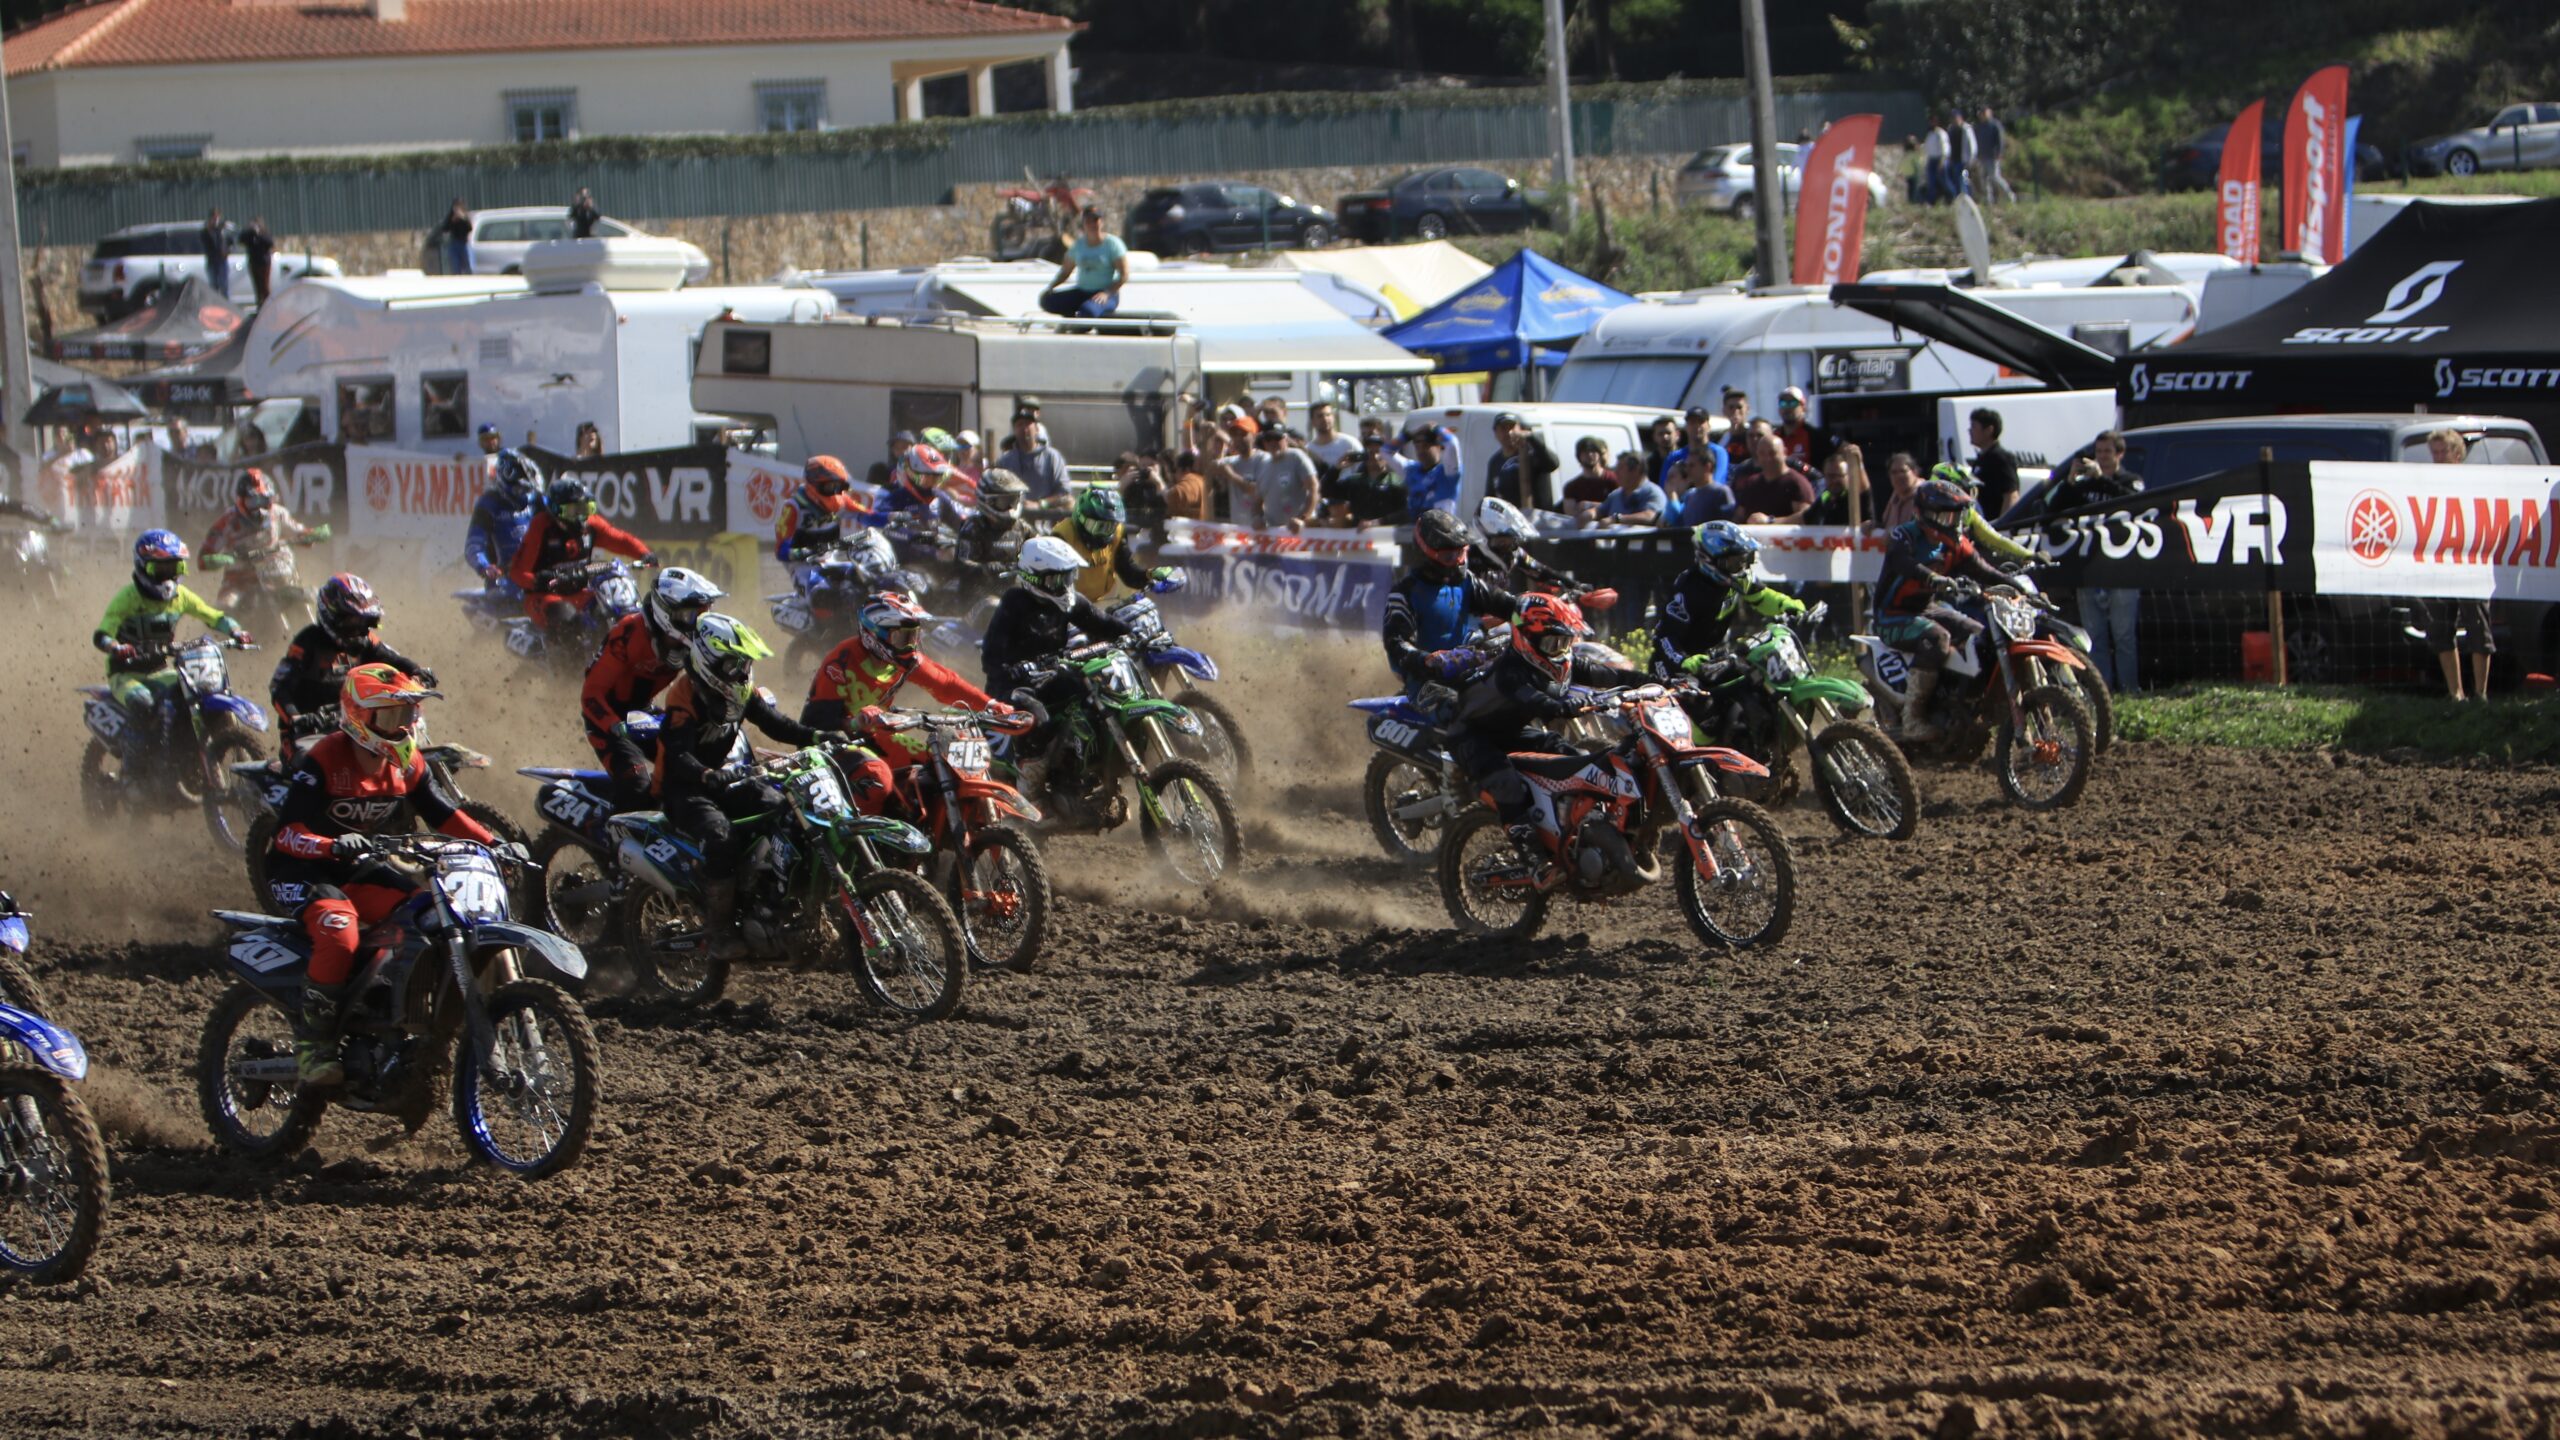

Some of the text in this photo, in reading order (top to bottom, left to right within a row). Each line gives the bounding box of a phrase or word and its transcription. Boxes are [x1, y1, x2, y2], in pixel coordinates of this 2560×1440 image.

[2282, 326, 2450, 344] SCOTT
[2152, 371, 2253, 391] SCOTT
[395, 462, 492, 516] YAMAH
[645, 466, 713, 522] VR
[2172, 493, 2288, 566] VR
[1375, 719, 1419, 748] 801
[543, 789, 592, 828] 234
[646, 838, 677, 864] 29
[443, 871, 499, 914] 207
[230, 934, 301, 974] 207
